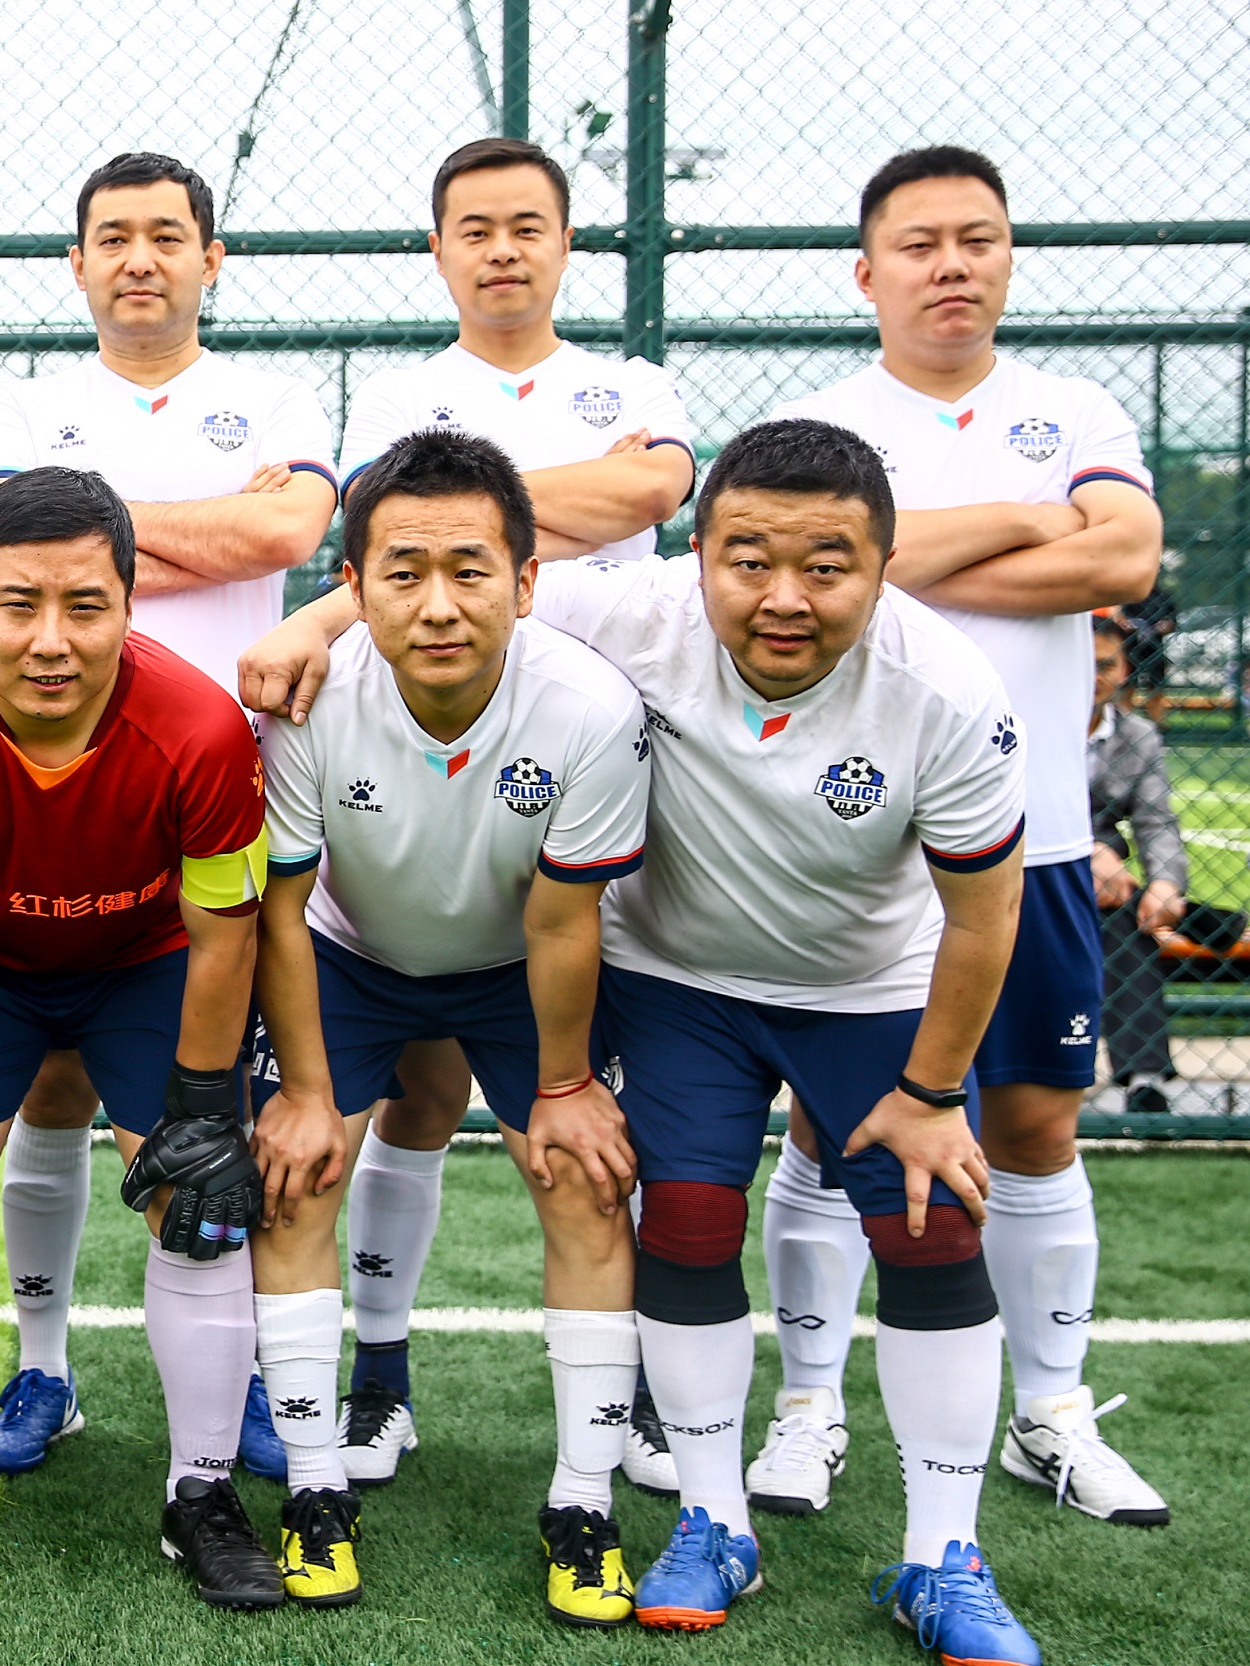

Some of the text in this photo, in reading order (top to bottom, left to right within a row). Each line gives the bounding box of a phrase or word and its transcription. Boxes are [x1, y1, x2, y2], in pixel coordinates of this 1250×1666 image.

[202, 426, 250, 439] POLICE
[51, 439, 87, 450] KELME
[1009, 435, 1062, 447] POLICE
[499, 782, 558, 799] POLICE
[821, 780, 884, 803] POLICE
[338, 799, 383, 813] KELME
[1060, 1035, 1093, 1046] KELME
[14, 1288, 54, 1297] KELME
[275, 1410, 321, 1420] KELME
[193, 1456, 237, 1468] Jom
